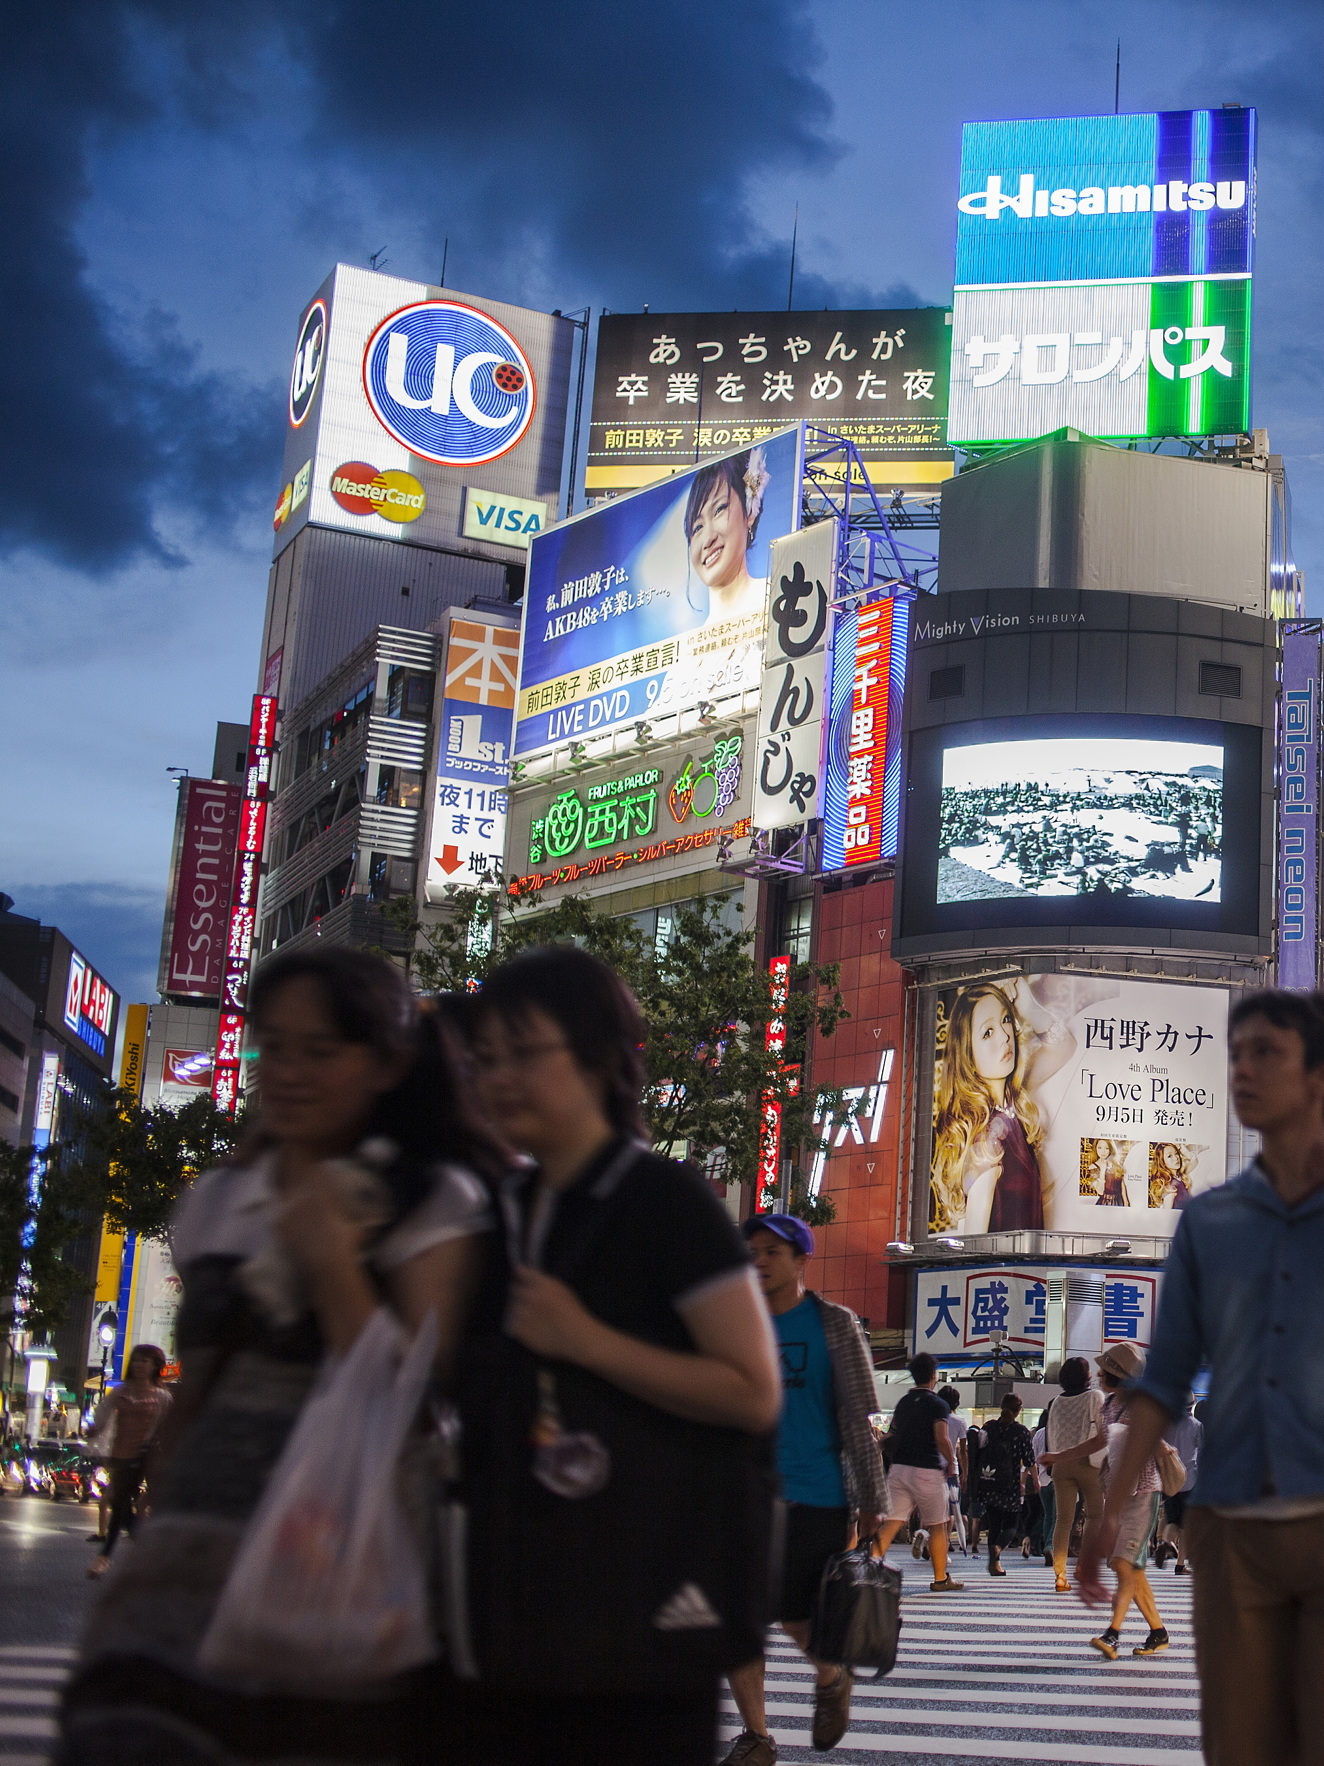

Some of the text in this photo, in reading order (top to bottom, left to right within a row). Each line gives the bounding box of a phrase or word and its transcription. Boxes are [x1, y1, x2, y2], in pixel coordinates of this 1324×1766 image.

[958, 174, 1245, 219] Hisamitsu
[648, 328, 907, 365] あっちゃんが
[965, 326, 1232, 388] サロンパス
[615, 369, 936, 405] 卒業を決めた夜
[605, 428, 684, 449] 前田敦子
[840, 424, 941, 435] さいたまスーパーアリーナ
[330, 475, 424, 510] MasterCard
[474, 501, 542, 535] VISA
[914, 612, 1086, 642] Mighty Vision SHIBUYA
[446, 625, 519, 705] 本
[526, 674, 581, 714] 前田敦子
[760, 561, 828, 814] もんじゃ
[547, 704, 584, 741] LIVE
[588, 689, 630, 728] DVD
[843, 609, 880, 849] 三千里薬品
[448, 717, 463, 756] BOOK
[446, 757, 511, 777] ブックファースト
[451, 813, 495, 840] まで
[583, 788, 658, 849] 西村
[1283, 678, 1313, 942] Taisei neon
[530, 820, 545, 864] 渋谷
[172, 787, 227, 986] Essential
[1083, 1016, 1214, 1057] 西野カナ
[1128, 1063, 1168, 1075] 4th Album
[1095, 1106, 1194, 1128] 9月5日 発売!
